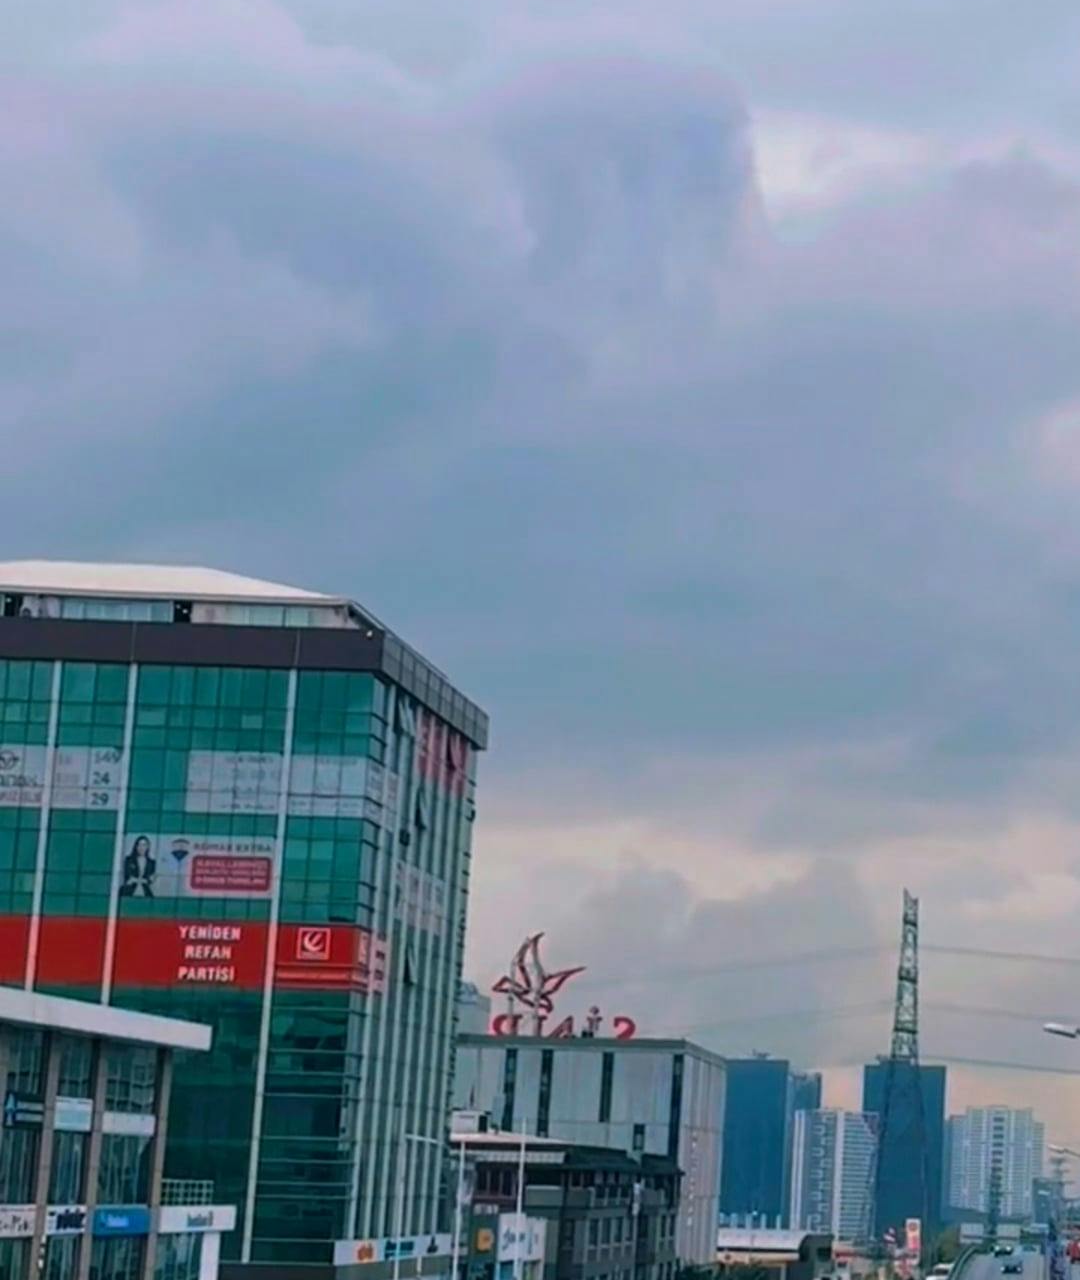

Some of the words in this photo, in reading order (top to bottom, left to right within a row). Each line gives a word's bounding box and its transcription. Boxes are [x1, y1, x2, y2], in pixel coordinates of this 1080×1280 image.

[178, 924, 241, 941] YENİDEN
[184, 945, 232, 960] REFAH
[177, 965, 236, 982] PARTİSİ
